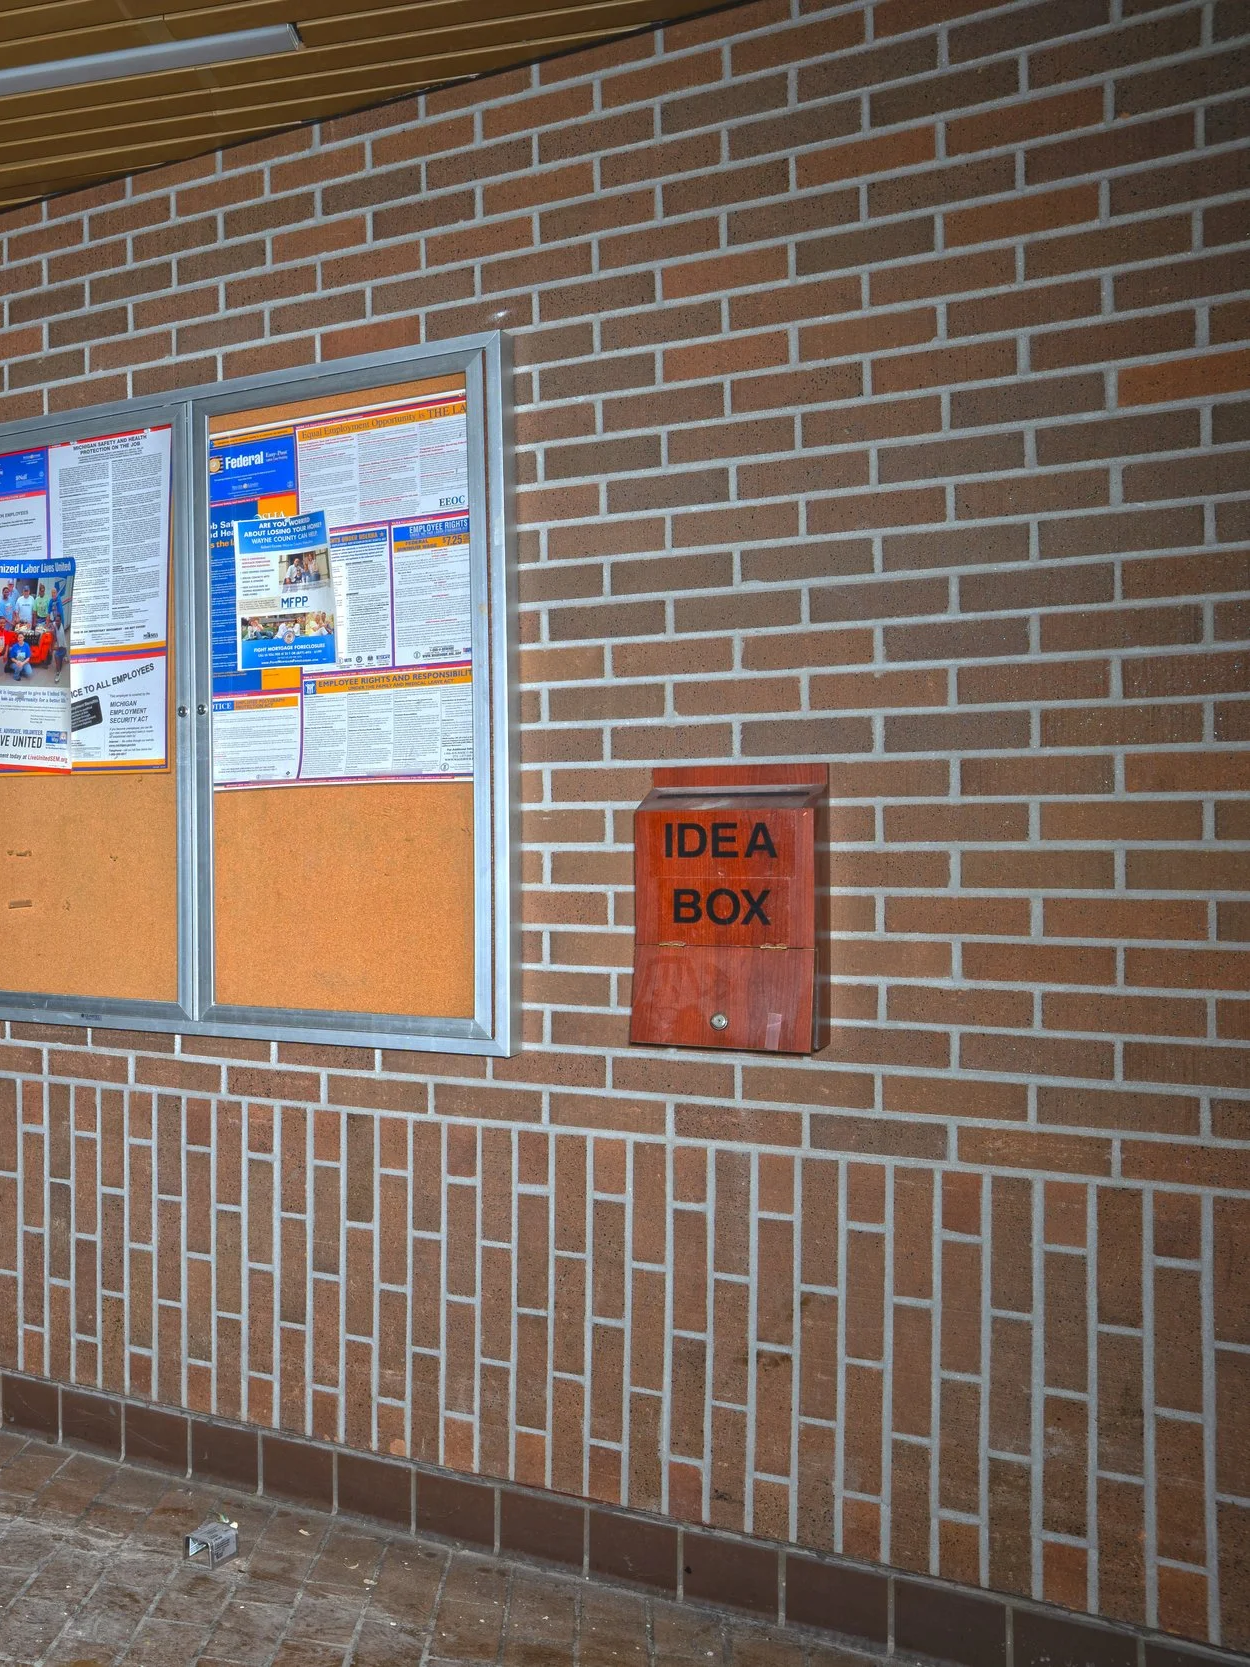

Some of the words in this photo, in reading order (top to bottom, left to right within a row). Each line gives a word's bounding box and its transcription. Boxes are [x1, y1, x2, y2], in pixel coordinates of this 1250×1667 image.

[301, 428, 322, 440] Equal
[324, 422, 369, 435] Employment
[371, 414, 415, 428] Opportunity
[419, 411, 425, 419] is
[426, 407, 449, 417] THE
[97, 439, 116, 447] SAFETY
[128, 434, 147, 442] HEALTH
[80, 446, 110, 455] PROTECTION
[225, 451, 264, 469] Federal
[439, 495, 466, 507] EEOC
[288, 517, 310, 526] WORRIED
[410, 522, 443, 534] EMPLOYEE
[444, 519, 468, 529] RIGHTS
[243, 530, 266, 538] ABOUT
[267, 527, 291, 535] LOSING
[215, 540, 229, 548] the
[20, 564, 40, 574] Labor
[40, 562, 54, 572] Lives
[54, 561, 71, 571] United
[281, 596, 309, 608] MFPP
[83, 684, 95, 694] TO
[96, 680, 111, 690] ALL
[111, 663, 154, 685] EMPLOYEES
[318, 678, 358, 688] EMPLOYEE
[360, 675, 391, 684] RIGHTS
[391, 674, 410, 682] AND
[412, 669, 472, 680] RESPONSIBILIT
[12, 735, 43, 748] UNITED
[664, 822, 777, 859] IDEA
[672, 888, 771, 925] BOX
